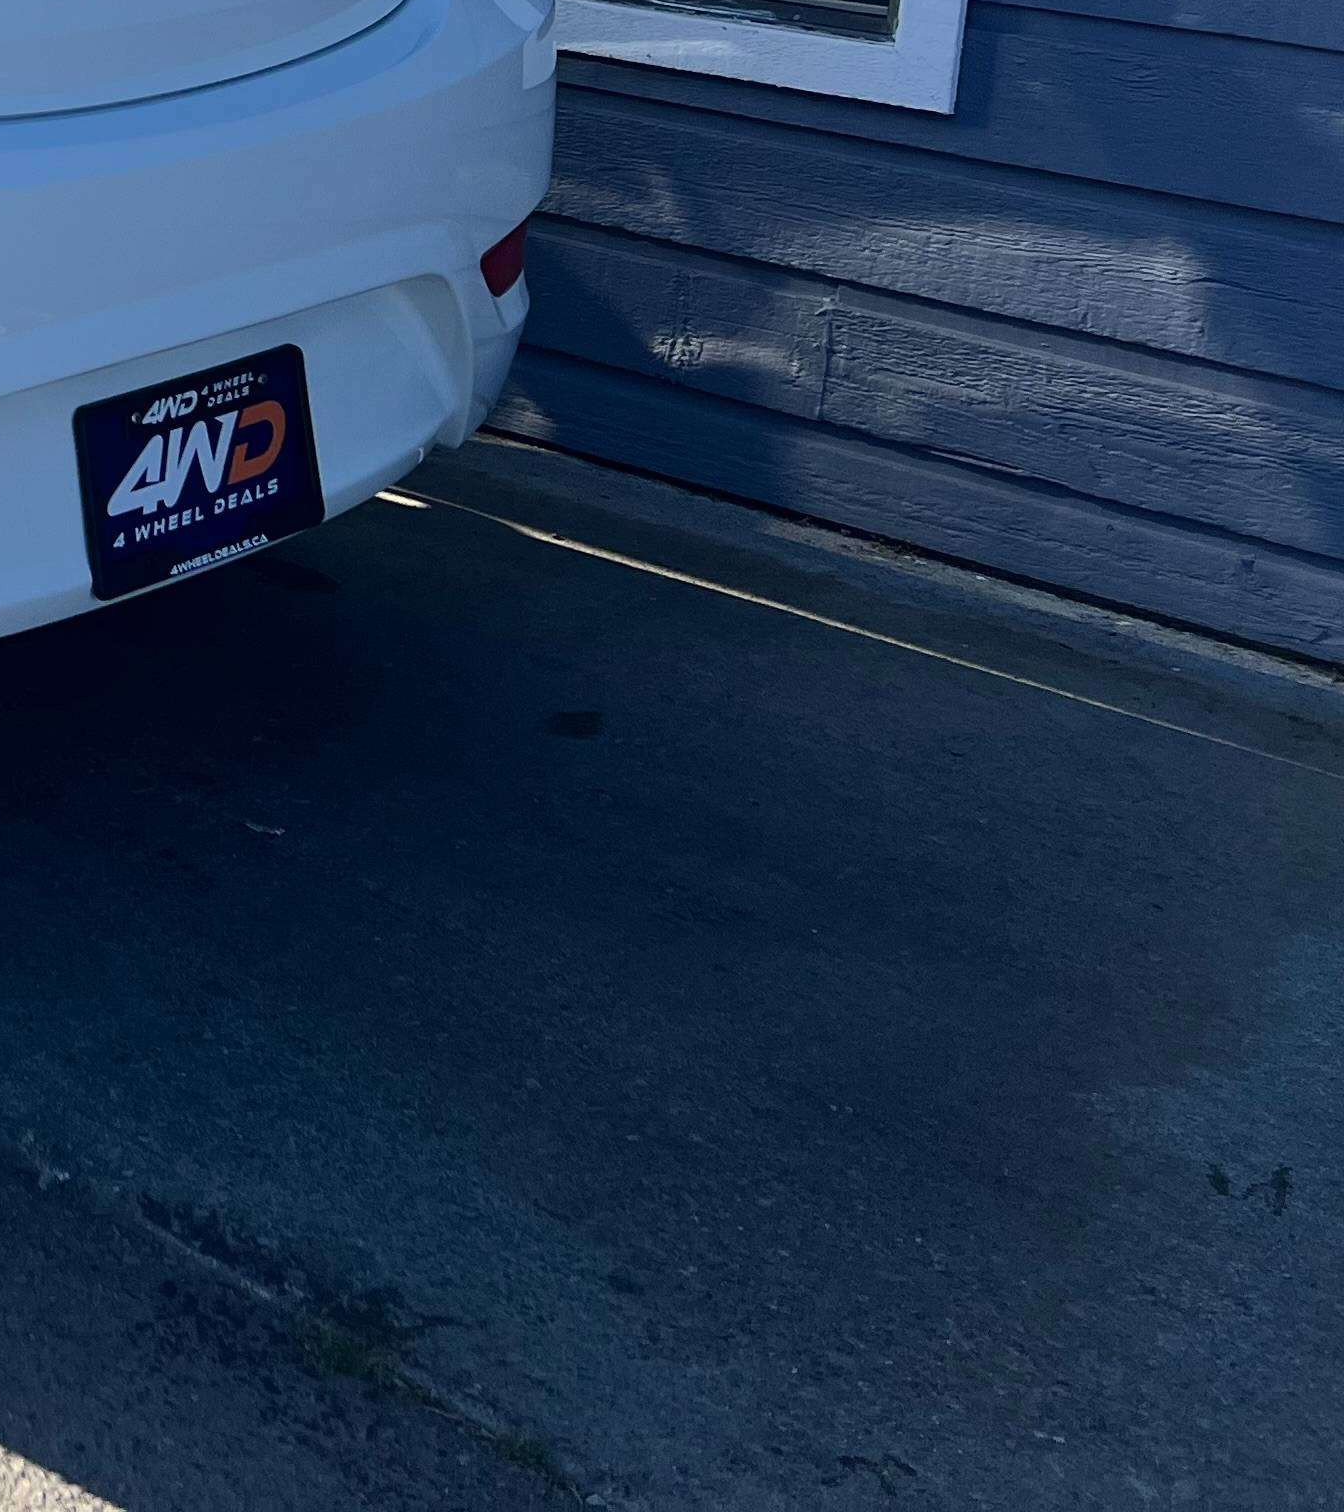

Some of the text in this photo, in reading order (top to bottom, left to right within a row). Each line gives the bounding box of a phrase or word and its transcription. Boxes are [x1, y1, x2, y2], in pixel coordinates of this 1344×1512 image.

[142, 390, 198, 424] 4WD
[213, 371, 254, 394] WHEEL
[207, 386, 250, 407] DEALS
[107, 400, 286, 517] 4WD
[113, 478, 279, 548] 4 WHEEL DEALS
